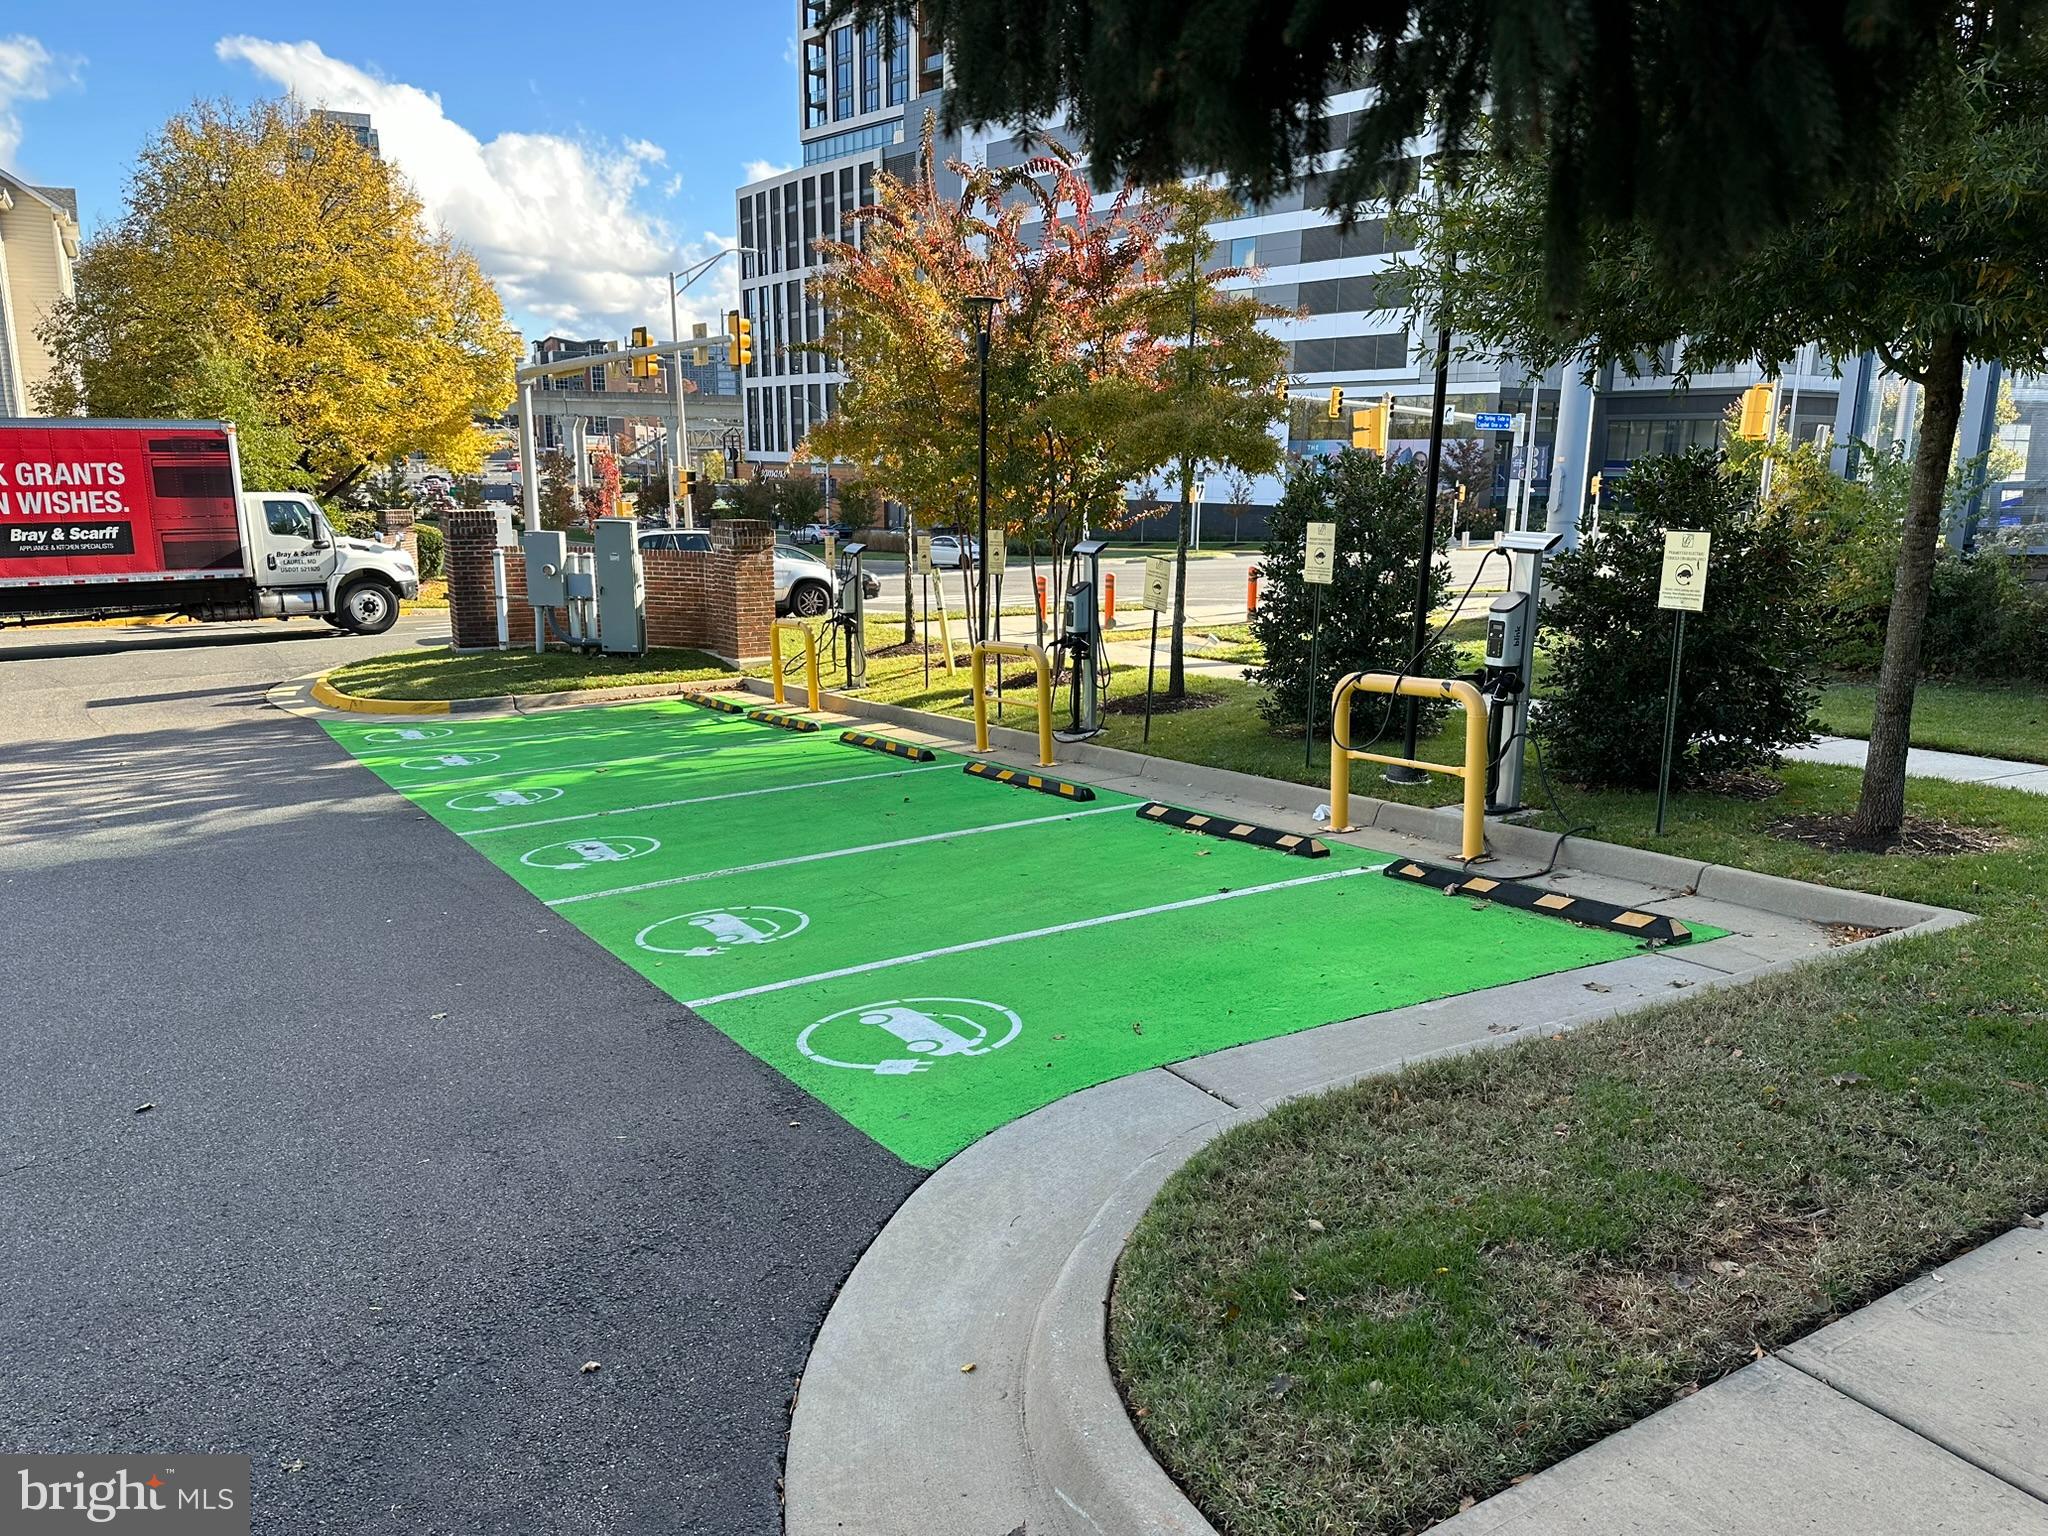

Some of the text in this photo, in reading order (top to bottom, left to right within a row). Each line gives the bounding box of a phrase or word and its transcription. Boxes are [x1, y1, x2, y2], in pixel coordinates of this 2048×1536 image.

[15, 462, 125, 486] GRANTS
[16, 490, 130, 514] WISHES.
[10, 526, 119, 544] Bray & Scarff
[19, 544, 49, 552] APPLIANCE
[56, 543, 80, 551] KITCHEN
[80, 542, 114, 550] SPECIALISTS
[1513, 624, 1521, 647] blink
